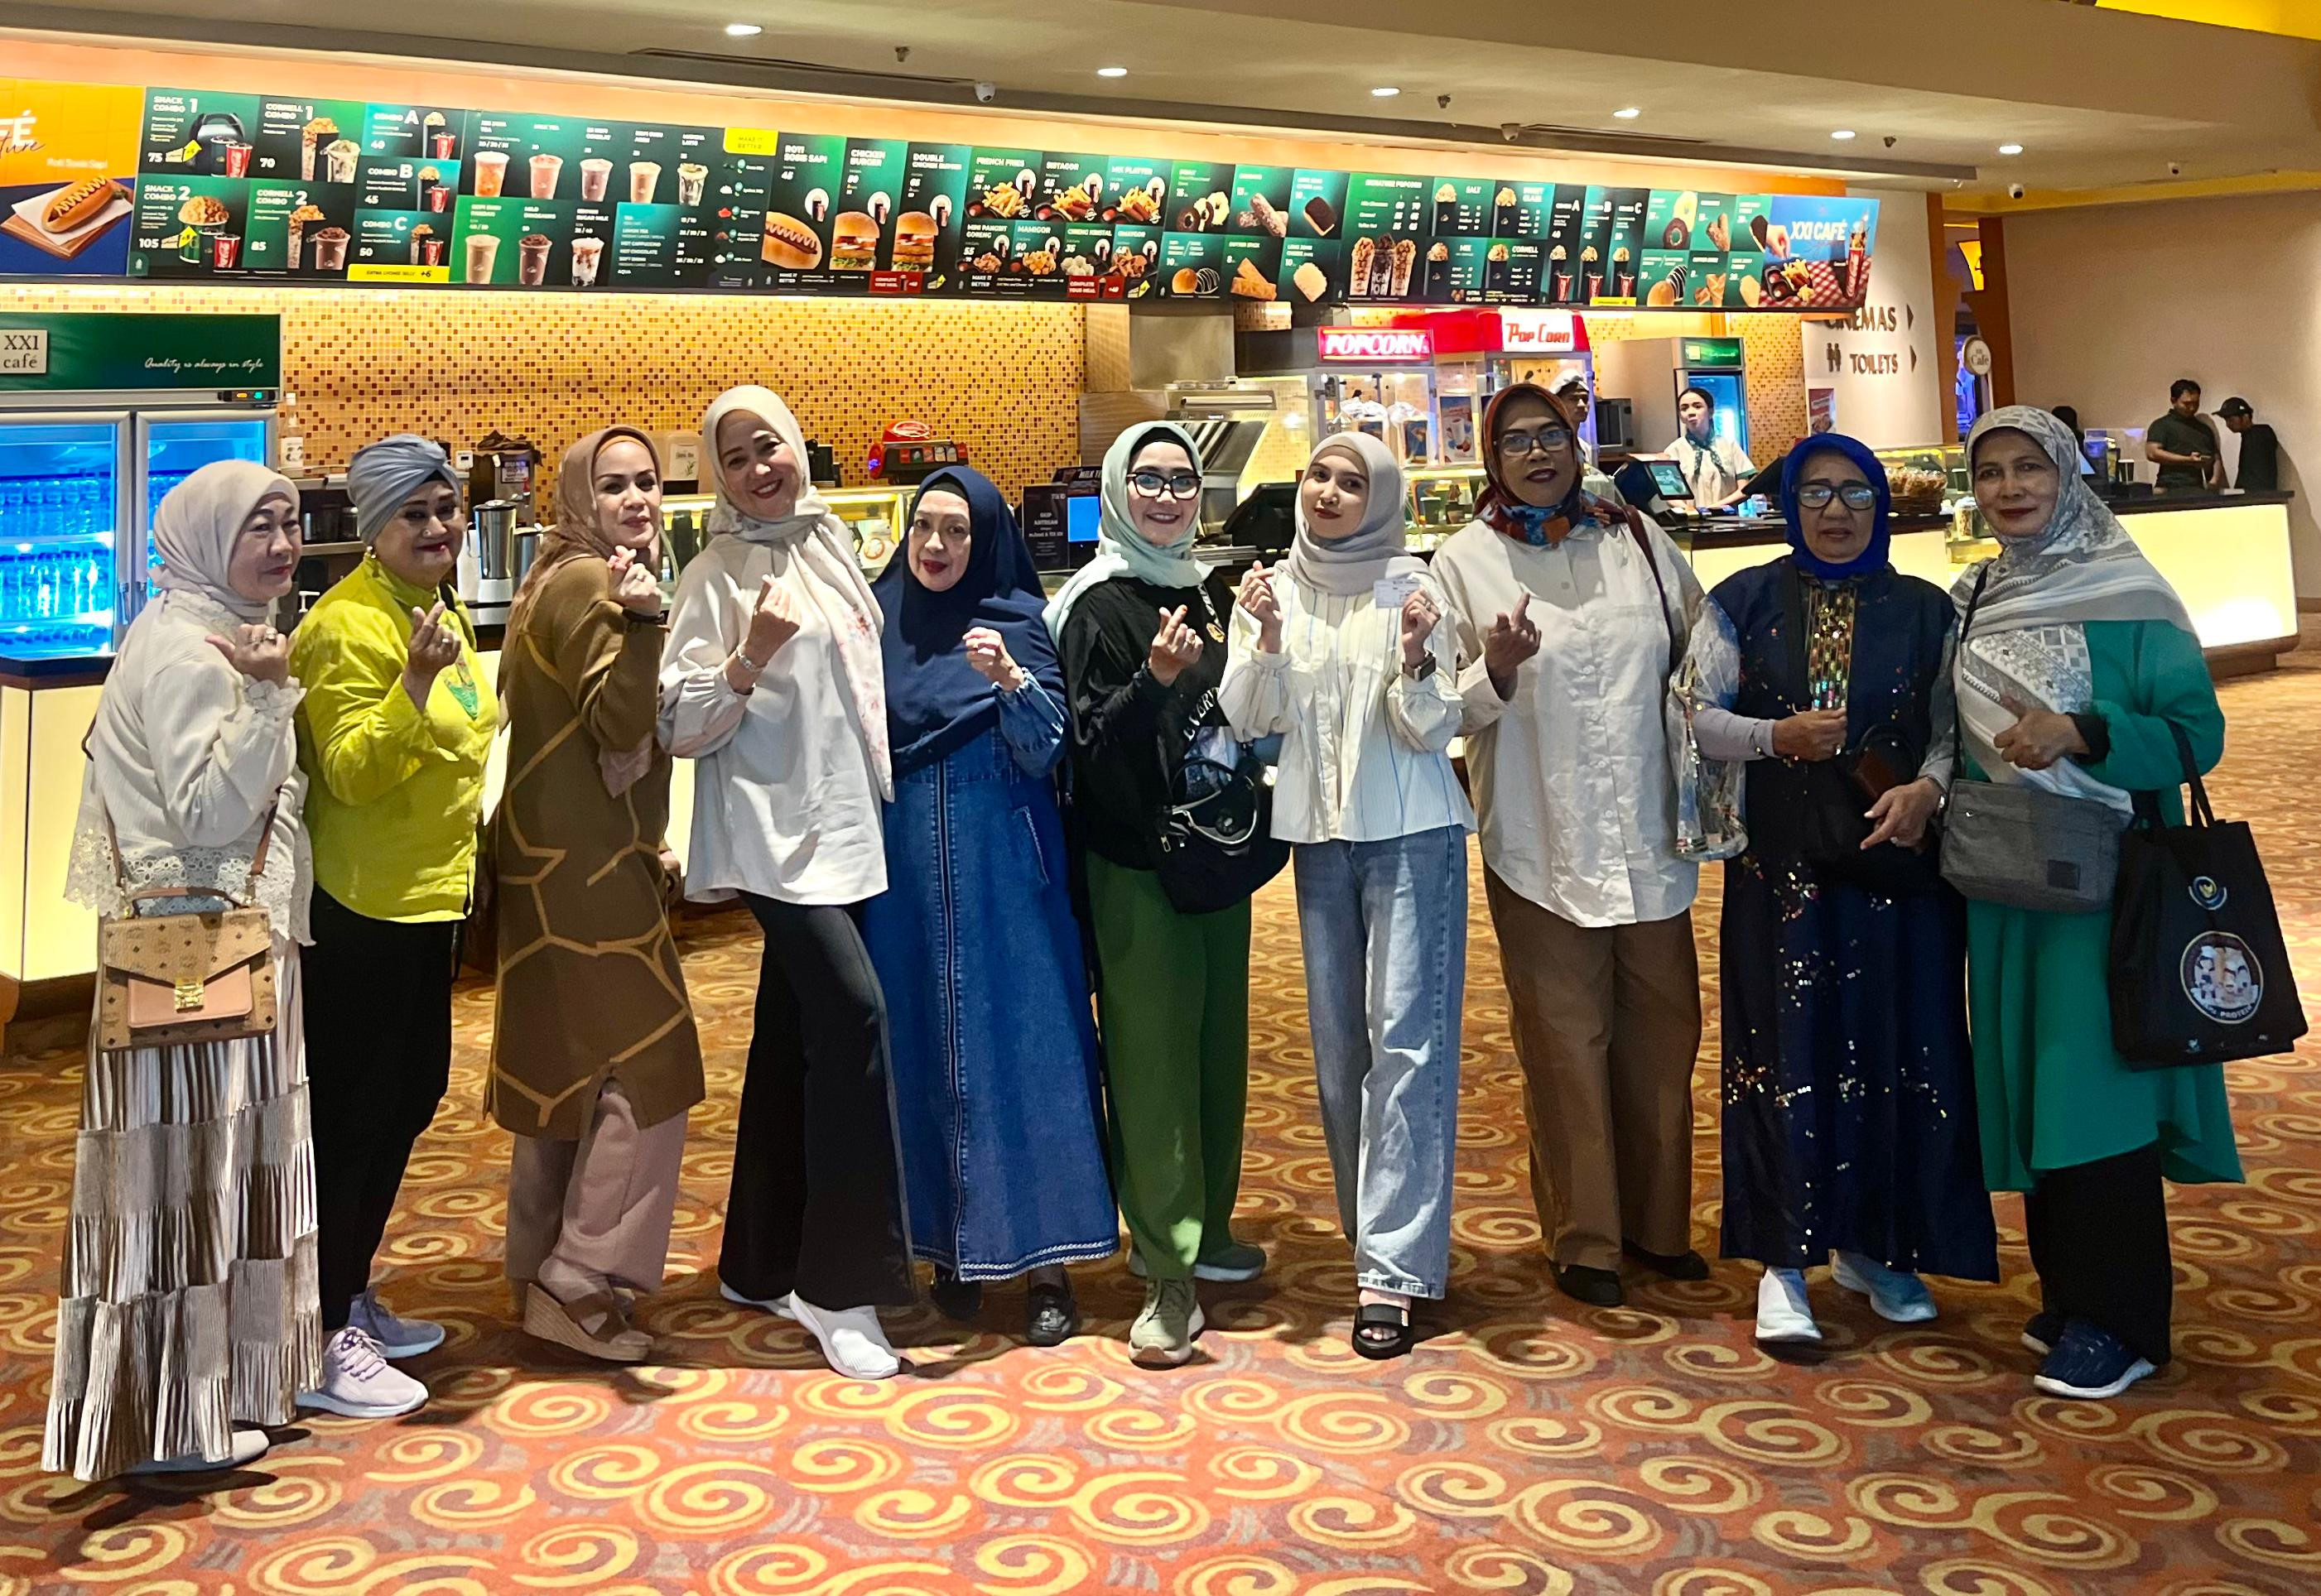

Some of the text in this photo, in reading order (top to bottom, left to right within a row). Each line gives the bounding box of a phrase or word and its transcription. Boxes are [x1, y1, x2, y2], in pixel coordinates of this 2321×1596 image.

[152, 103, 186, 113] COMBO
[189, 97, 199, 113] 1
[305, 105, 314, 121] 1
[403, 109, 420, 125] A
[147, 151, 163, 163] 75
[259, 157, 276, 169] 70
[399, 163, 413, 179] B
[143, 192, 177, 201] COMBO
[144, 184, 175, 194] SNACK
[177, 185, 191, 201] 2
[255, 196, 288, 205] COMBO
[295, 190, 308, 206] 2
[364, 195, 379, 204] 45
[394, 216, 408, 231] C
[1790, 218, 1848, 241] XXI CAFÉ
[138, 238, 160, 248] 105
[250, 241, 267, 252] 85
[359, 248, 373, 257] 50
[3, 334, 39, 350] XXI
[1326, 334, 1426, 354] POPCORN
[2, 353, 38, 369] café
[145, 357, 181, 373] Quality
[1850, 353, 1899, 374] TOILETS
